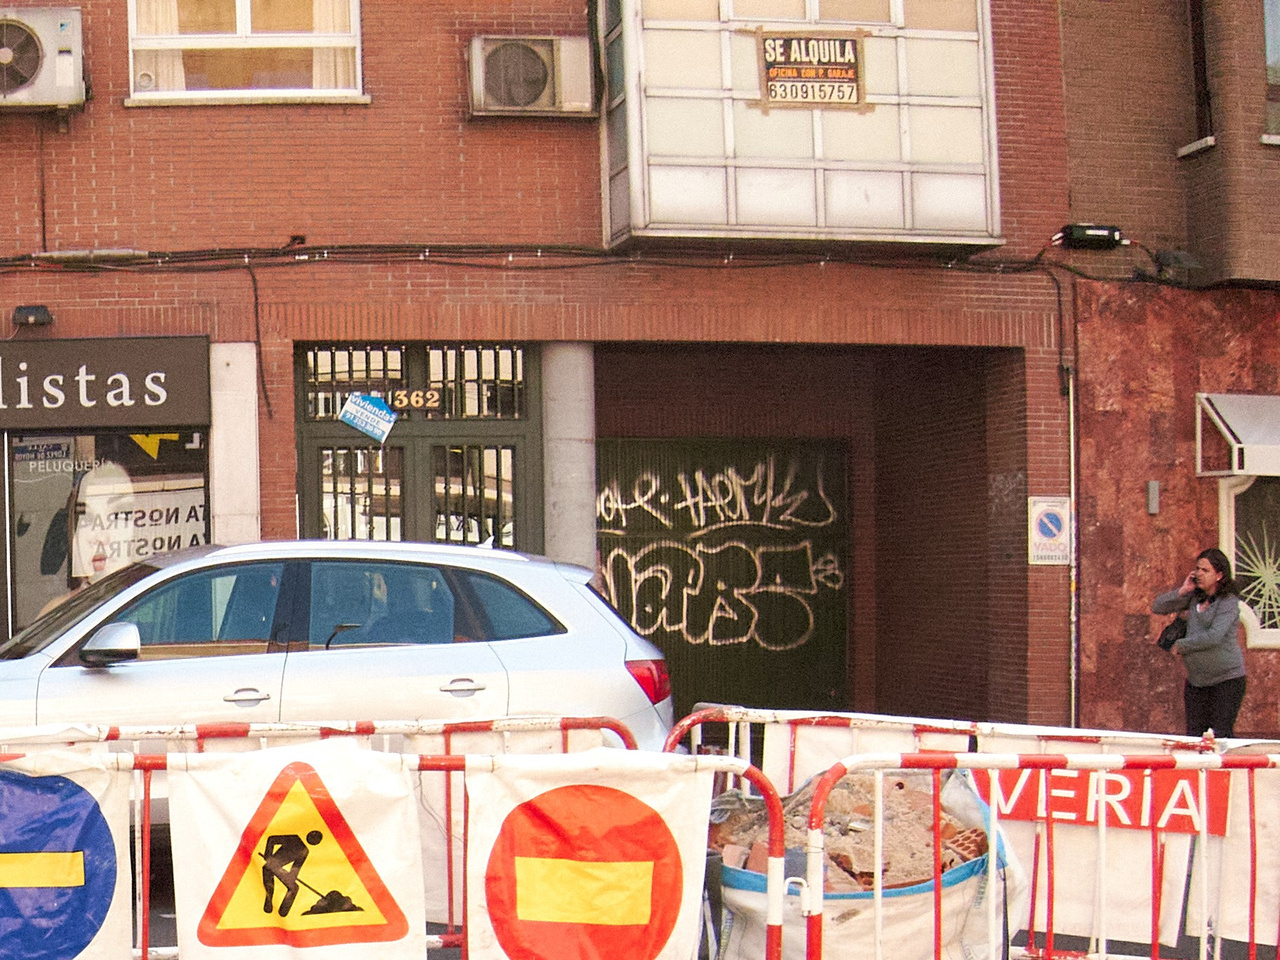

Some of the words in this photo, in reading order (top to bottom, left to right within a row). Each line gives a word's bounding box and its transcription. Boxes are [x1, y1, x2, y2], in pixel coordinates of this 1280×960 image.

[765, 39, 785, 62] SE
[790, 40, 856, 65] ALQUILA
[768, 67, 798, 78] OFICINA
[769, 84, 856, 100] 630915757
[394, 390, 440, 408] 362
[1034, 542, 1068, 552] VADO
